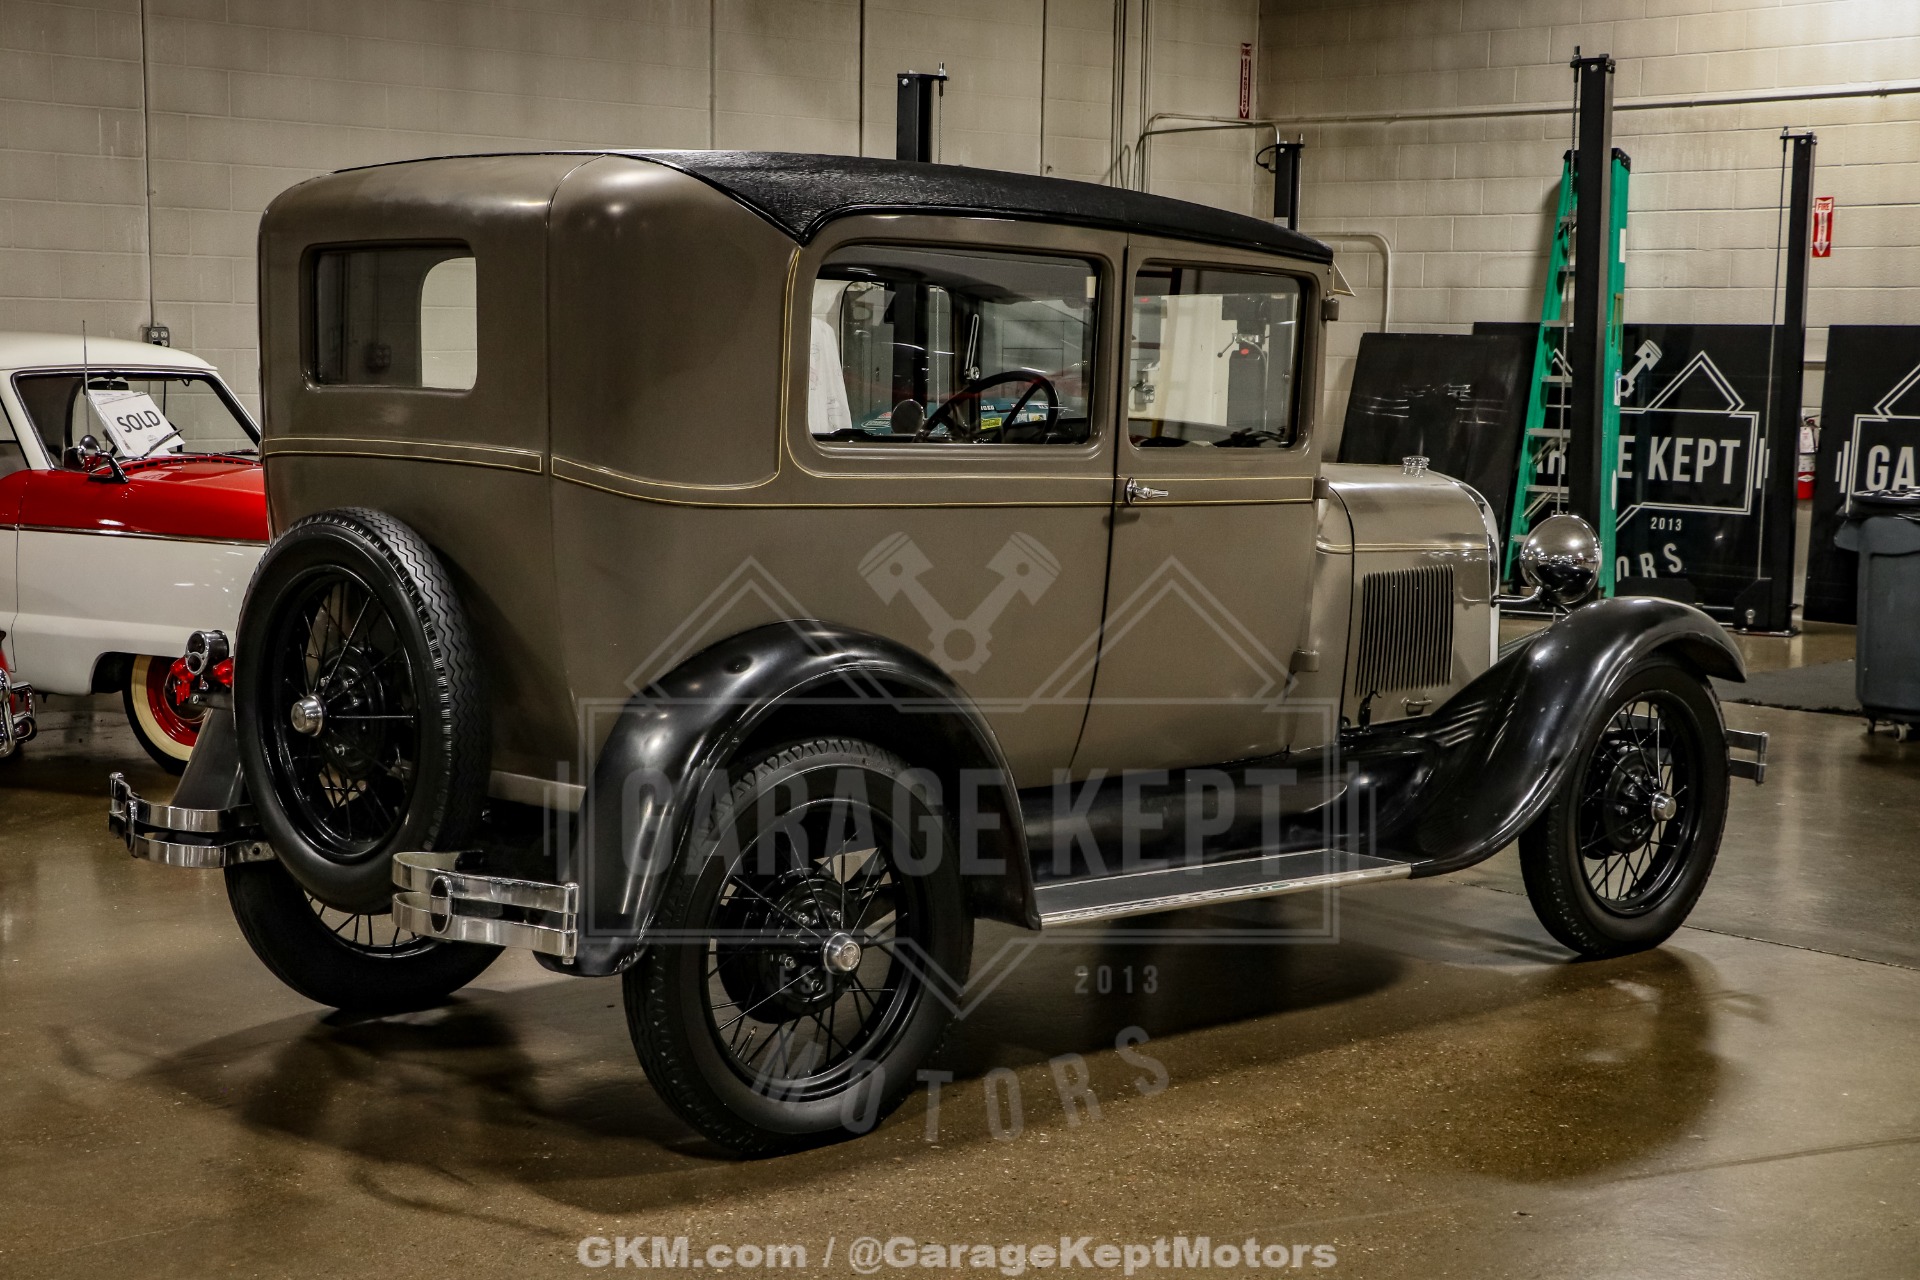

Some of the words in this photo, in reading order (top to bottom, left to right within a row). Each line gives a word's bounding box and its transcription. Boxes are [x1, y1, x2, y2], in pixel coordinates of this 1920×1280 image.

[1818, 202, 1830, 210] FIRE
[116, 410, 161, 433] SOLD
[1648, 436, 1741, 485] KEPT
[1650, 517, 1682, 532] 2013
